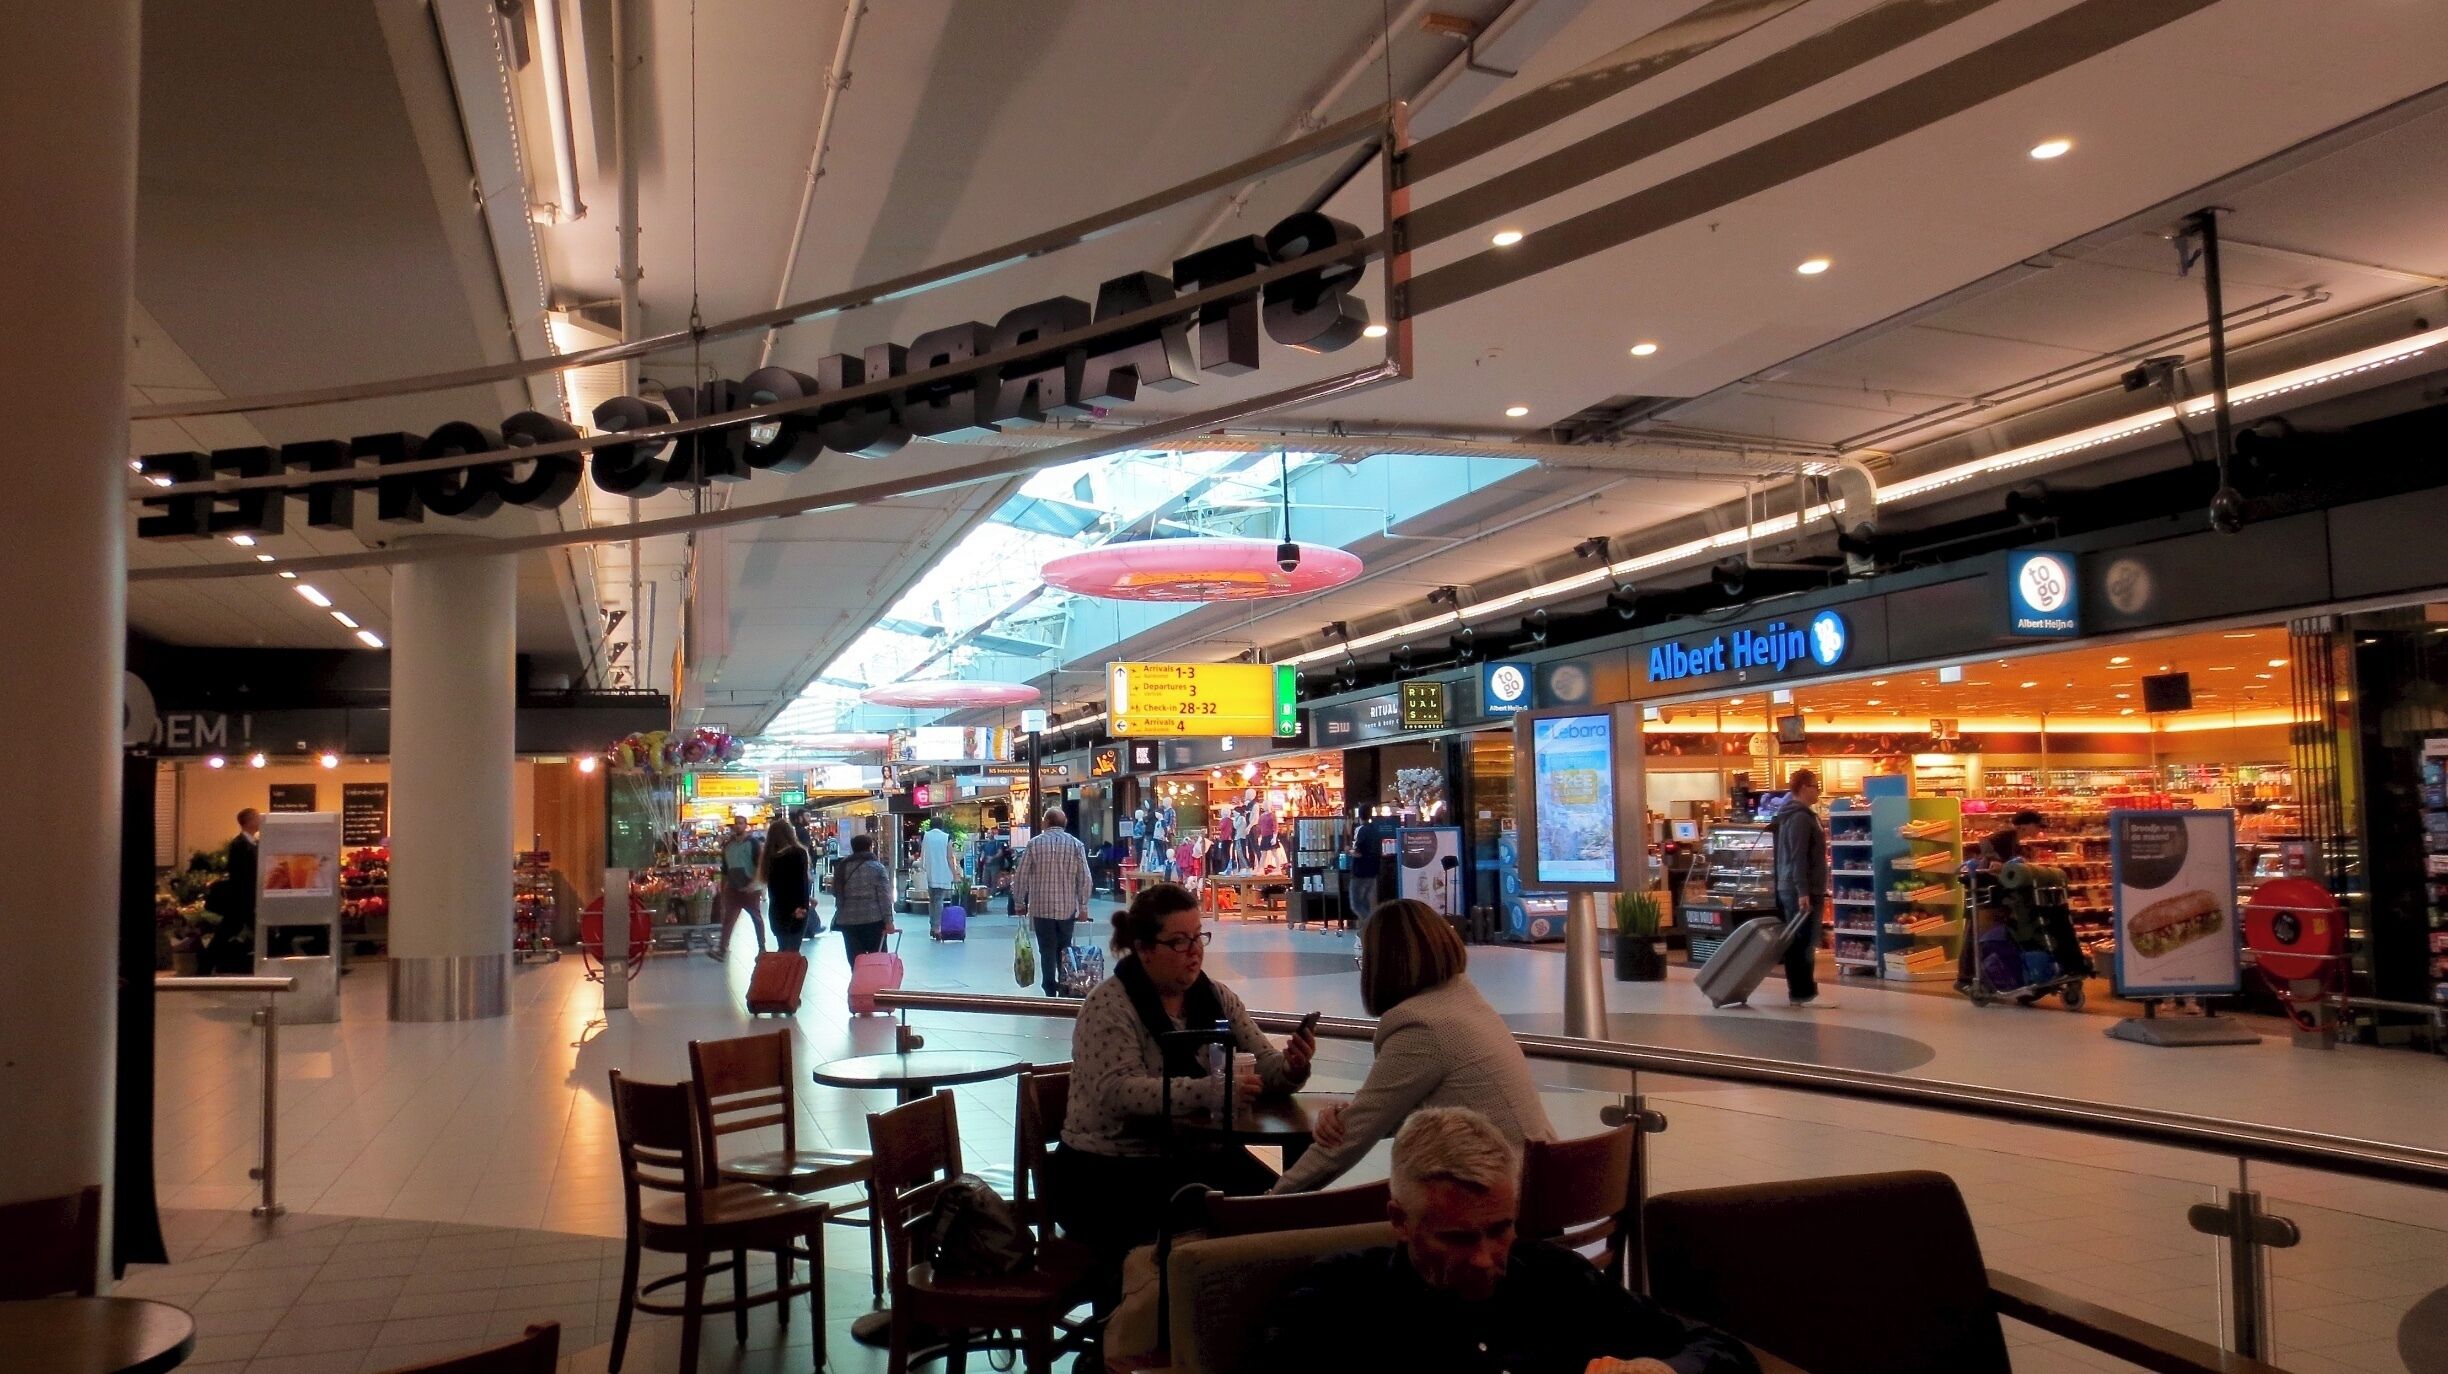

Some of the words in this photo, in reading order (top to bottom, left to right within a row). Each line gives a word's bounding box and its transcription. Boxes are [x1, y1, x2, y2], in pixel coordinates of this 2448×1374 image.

[2018, 618, 2044, 628] Albert
[2044, 619, 2066, 630] Heijn
[1649, 636, 1725, 682] Albert
[1732, 622, 1806, 672] Heijn
[1143, 665, 1174, 673] Arrivals
[1175, 667, 1196, 679] 1-3
[1143, 683, 1187, 691] Departures
[1189, 685, 1197, 697] 3
[1143, 703, 1178, 712] Check-in
[1179, 702, 1217, 714] 28-32
[1370, 703, 1398, 718] RITUAL
[1144, 718, 1175, 726] Arrivals
[1177, 720, 1185, 731] 4
[1552, 724, 1606, 739] Lebara
